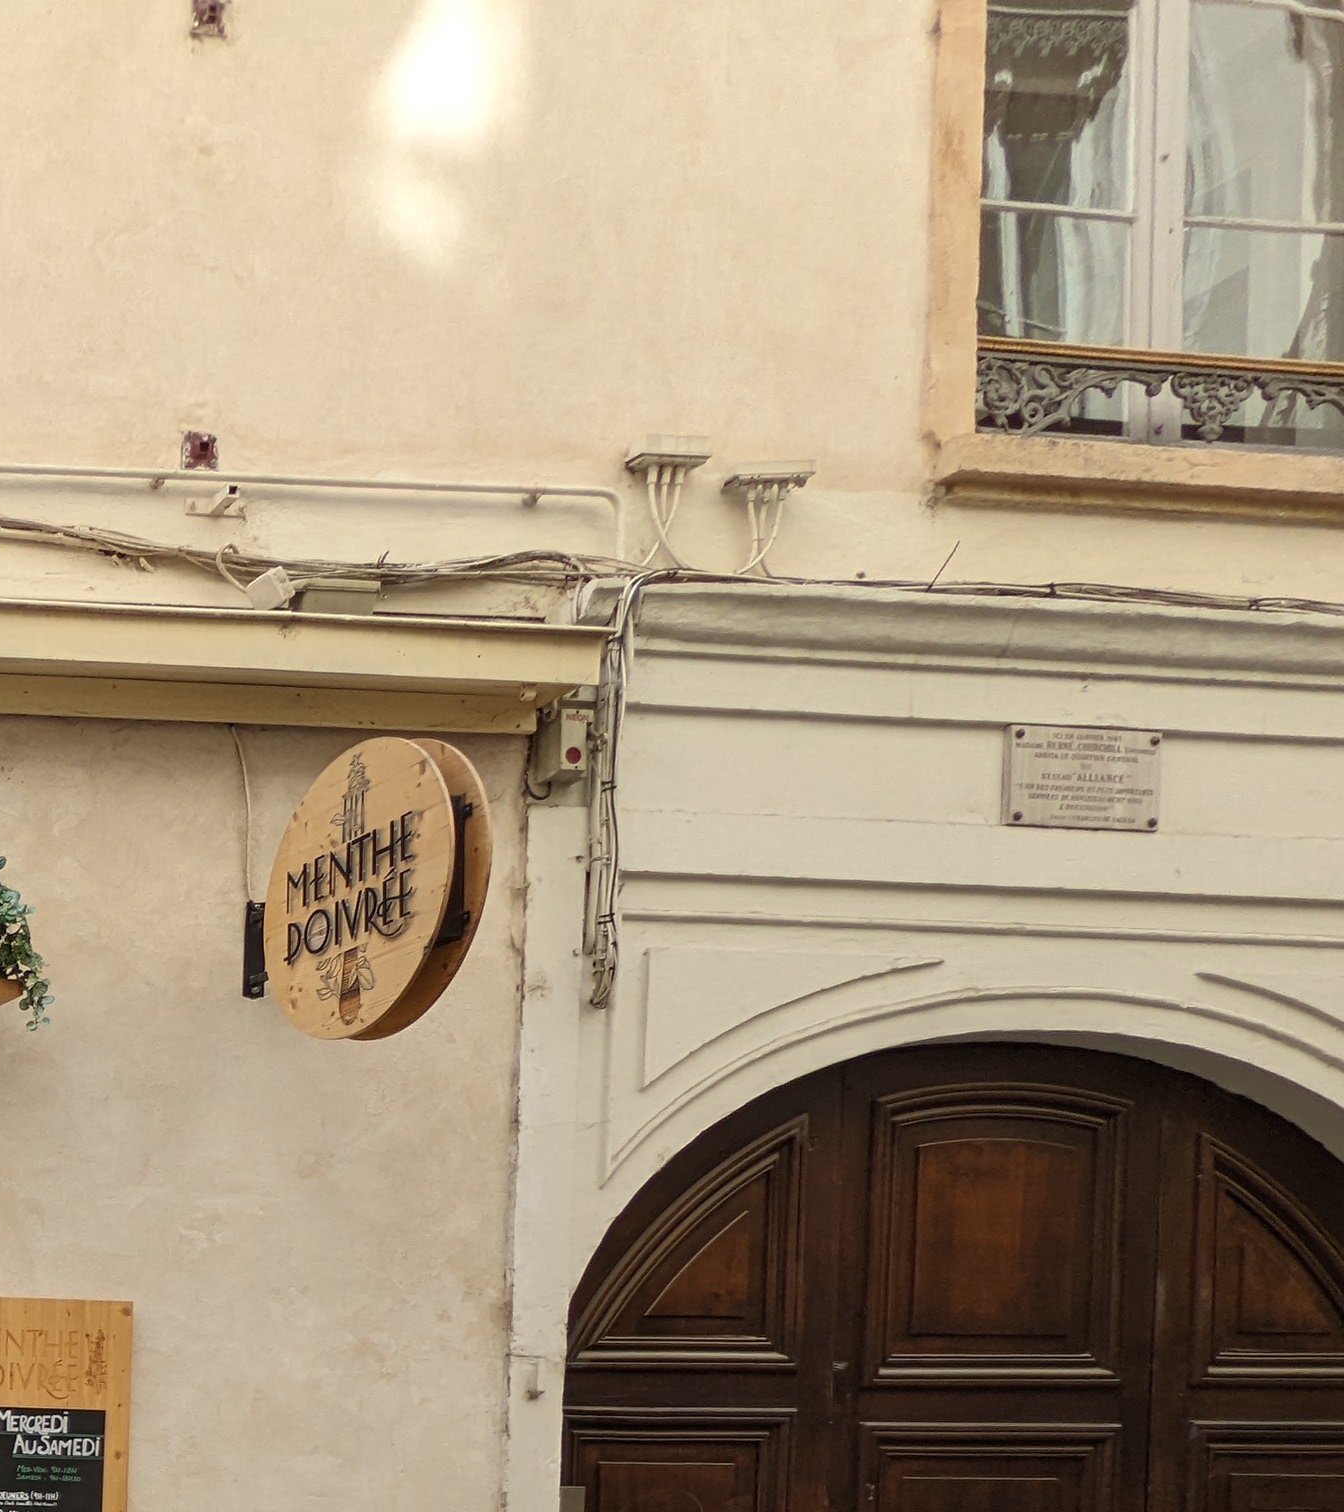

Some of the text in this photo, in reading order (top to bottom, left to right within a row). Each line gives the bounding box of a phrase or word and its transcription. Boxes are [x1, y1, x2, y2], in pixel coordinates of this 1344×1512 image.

[286, 810, 416, 914] MENTHE
[283, 868, 415, 965] POIVRÉE
[37, 1435, 100, 1457] SAMEDI
